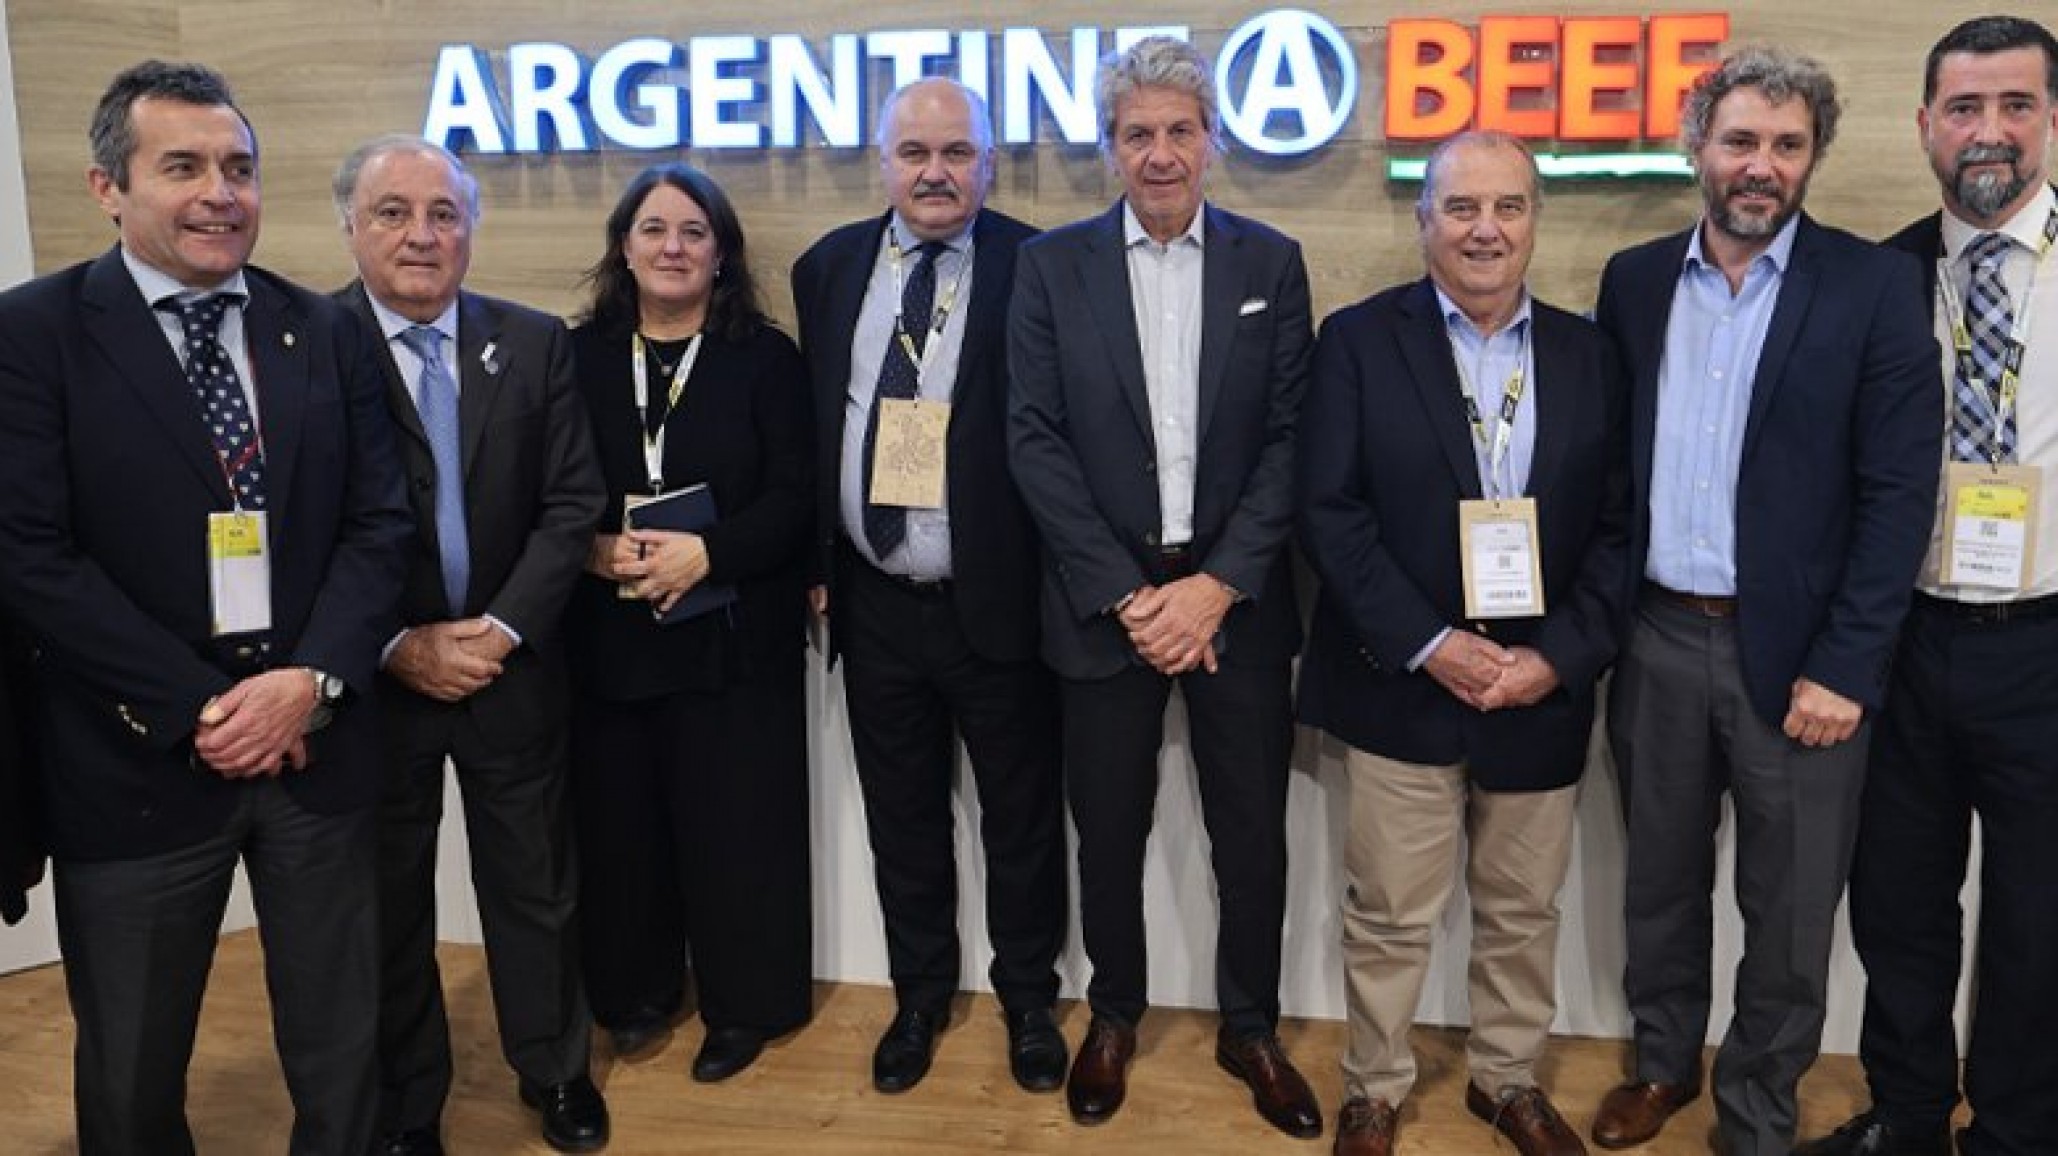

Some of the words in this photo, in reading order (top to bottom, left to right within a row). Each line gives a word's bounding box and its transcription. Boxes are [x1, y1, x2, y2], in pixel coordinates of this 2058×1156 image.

[423, 26, 1189, 153] ARGENTIN
[1230, 11, 1345, 143] A
[1385, 13, 1730, 141] BEEF
